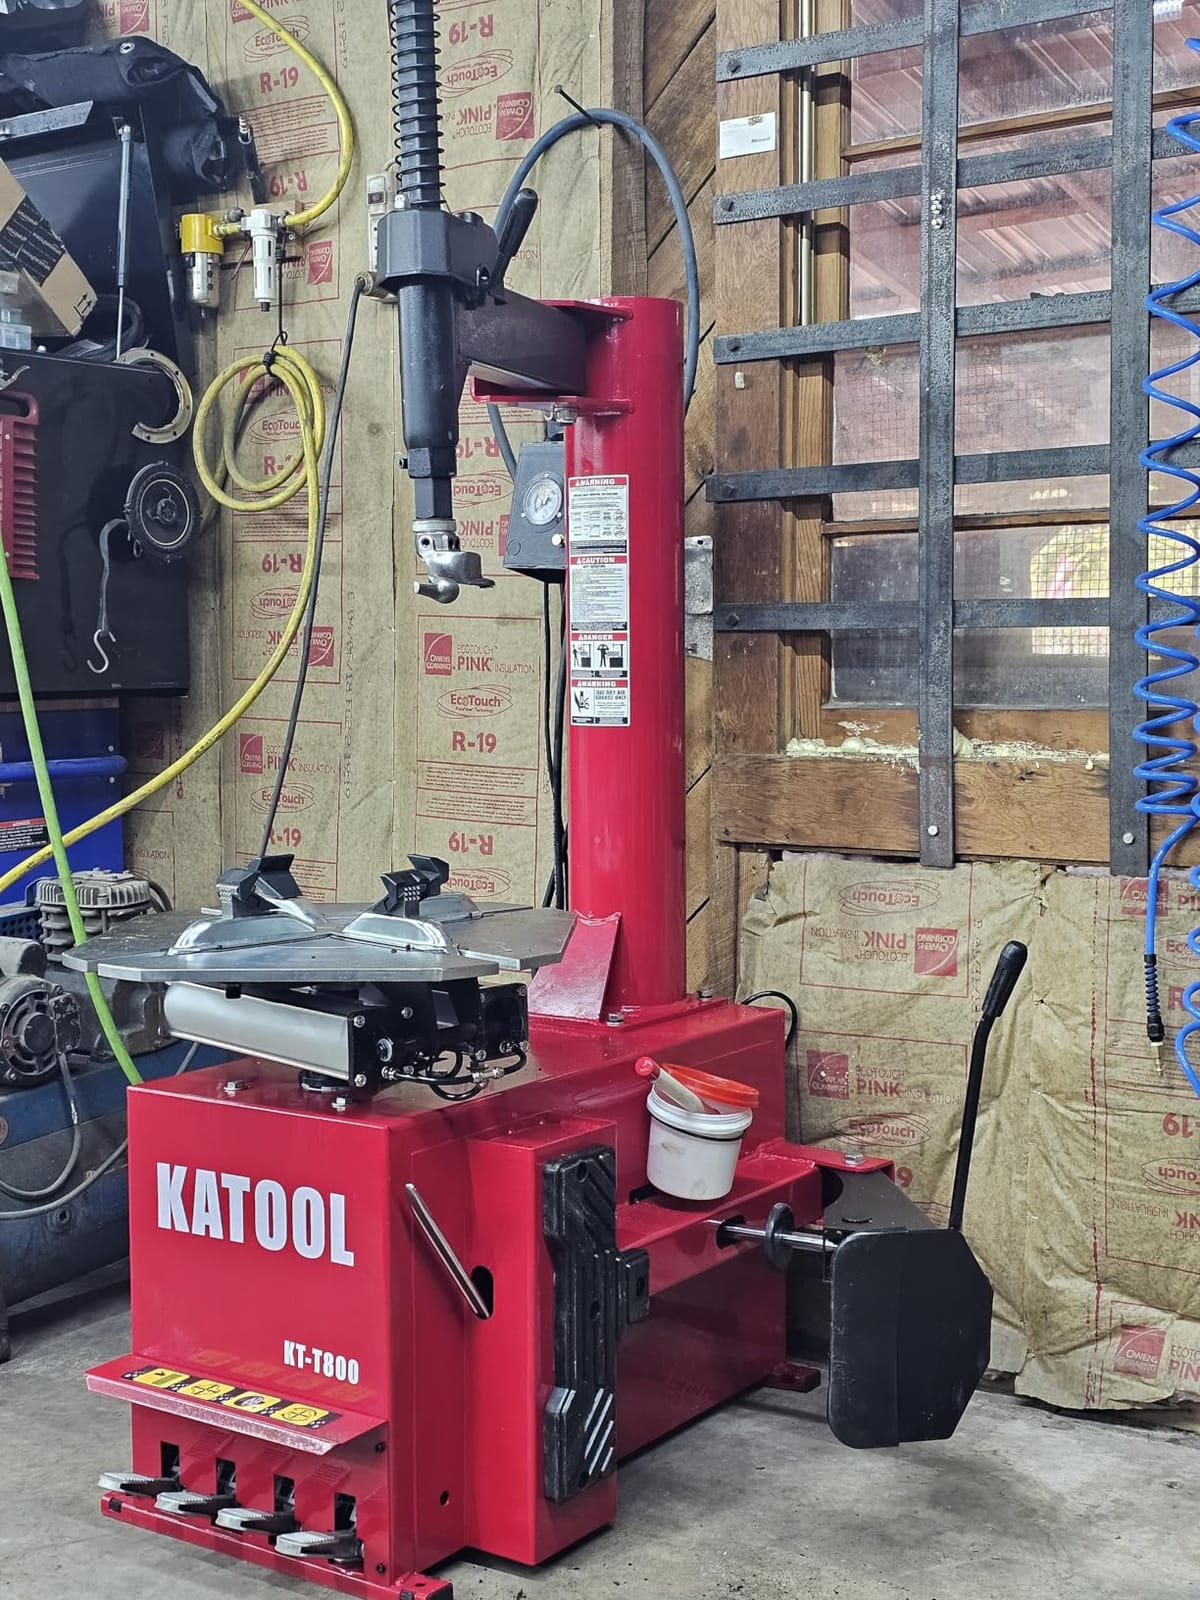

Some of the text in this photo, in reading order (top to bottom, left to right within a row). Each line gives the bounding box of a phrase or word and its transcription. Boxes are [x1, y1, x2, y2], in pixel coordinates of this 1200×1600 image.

[255, 27, 299, 47] EcoToh
[449, 14, 494, 45] R-19
[260, 66, 299, 93] R-19
[447, 65, 499, 86] EcoTouch
[459, 104, 492, 125] PINK
[269, 170, 308, 196] R-19
[268, 384, 292, 398] PIN
[262, 419, 300, 431] EcoTouc
[460, 521, 493, 536] PINK
[462, 538, 493, 548] ECOTOUC
[262, 553, 302, 573] R-19
[260, 597, 297, 608] coTouch
[267, 630, 299, 645] PNK
[457, 656, 535, 674] PINK INSULATION
[450, 694, 501, 707] EcoTouch
[452, 731, 497, 754] R-19
[299, 763, 336, 774] INSULATION
[261, 790, 305, 805] Ecouch
[449, 832, 493, 855] R-19
[447, 877, 495, 893] EcoTouch
[852, 891, 920, 907] EcoTouch
[863, 931, 907, 949] PINK
[917, 934, 955, 944] CORNING
[917, 942, 949, 952] OWENS
[860, 951, 908, 962] ECOTOUCH
[856, 1064, 906, 1079] ECOTOUCH
[857, 1079, 903, 1098] PINK
[850, 1120, 916, 1139] EcoTouch
[1163, 1112, 1200, 1138] -19
[1158, 1166, 1200, 1184] ouch
[157, 1161, 355, 1268] KATOOL
[1111, 1197, 1200, 1229] NK INSULATION
[1170, 1228, 1200, 1242] OUCH
[283, 1339, 359, 1385] KT-T800
[1126, 1349, 1158, 1364] OWENS
[1171, 1345, 1200, 1361] ECOTO
[1168, 1359, 1200, 1383] PIN
